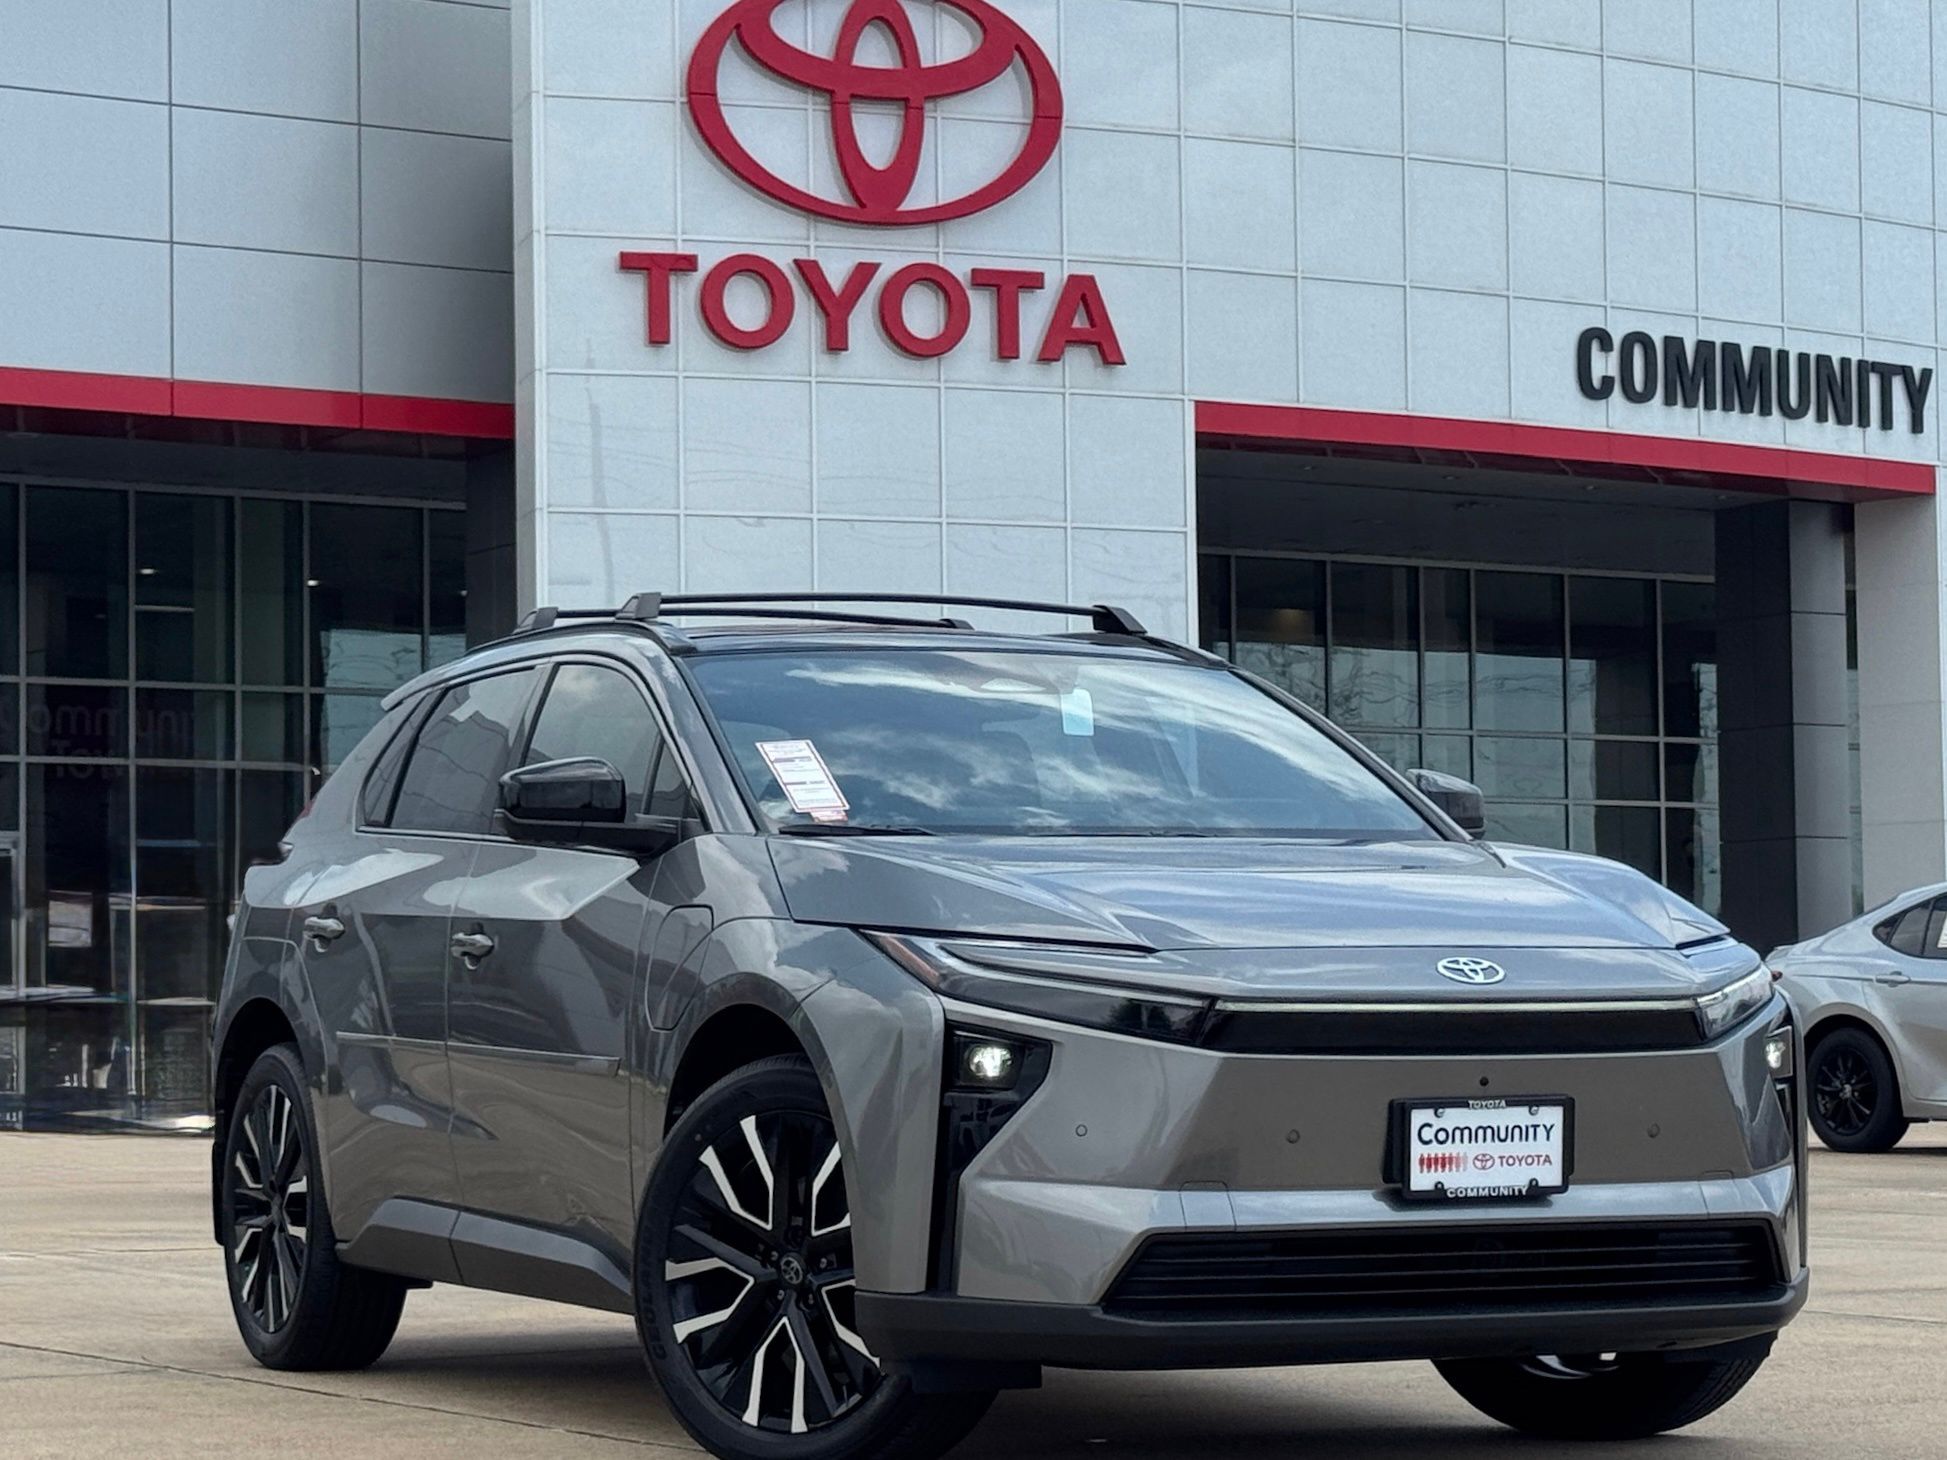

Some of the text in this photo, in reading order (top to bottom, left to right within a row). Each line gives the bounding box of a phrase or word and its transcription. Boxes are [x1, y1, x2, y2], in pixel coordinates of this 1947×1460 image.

[619, 251, 1127, 366] TOYOTA
[1577, 327, 1933, 434] COMMUNITY
[1467, 1099, 1507, 1109] TOYOTA
[1499, 1155, 1552, 1166] TOYOTA
[1447, 1186, 1528, 1197] COMMUNITY
